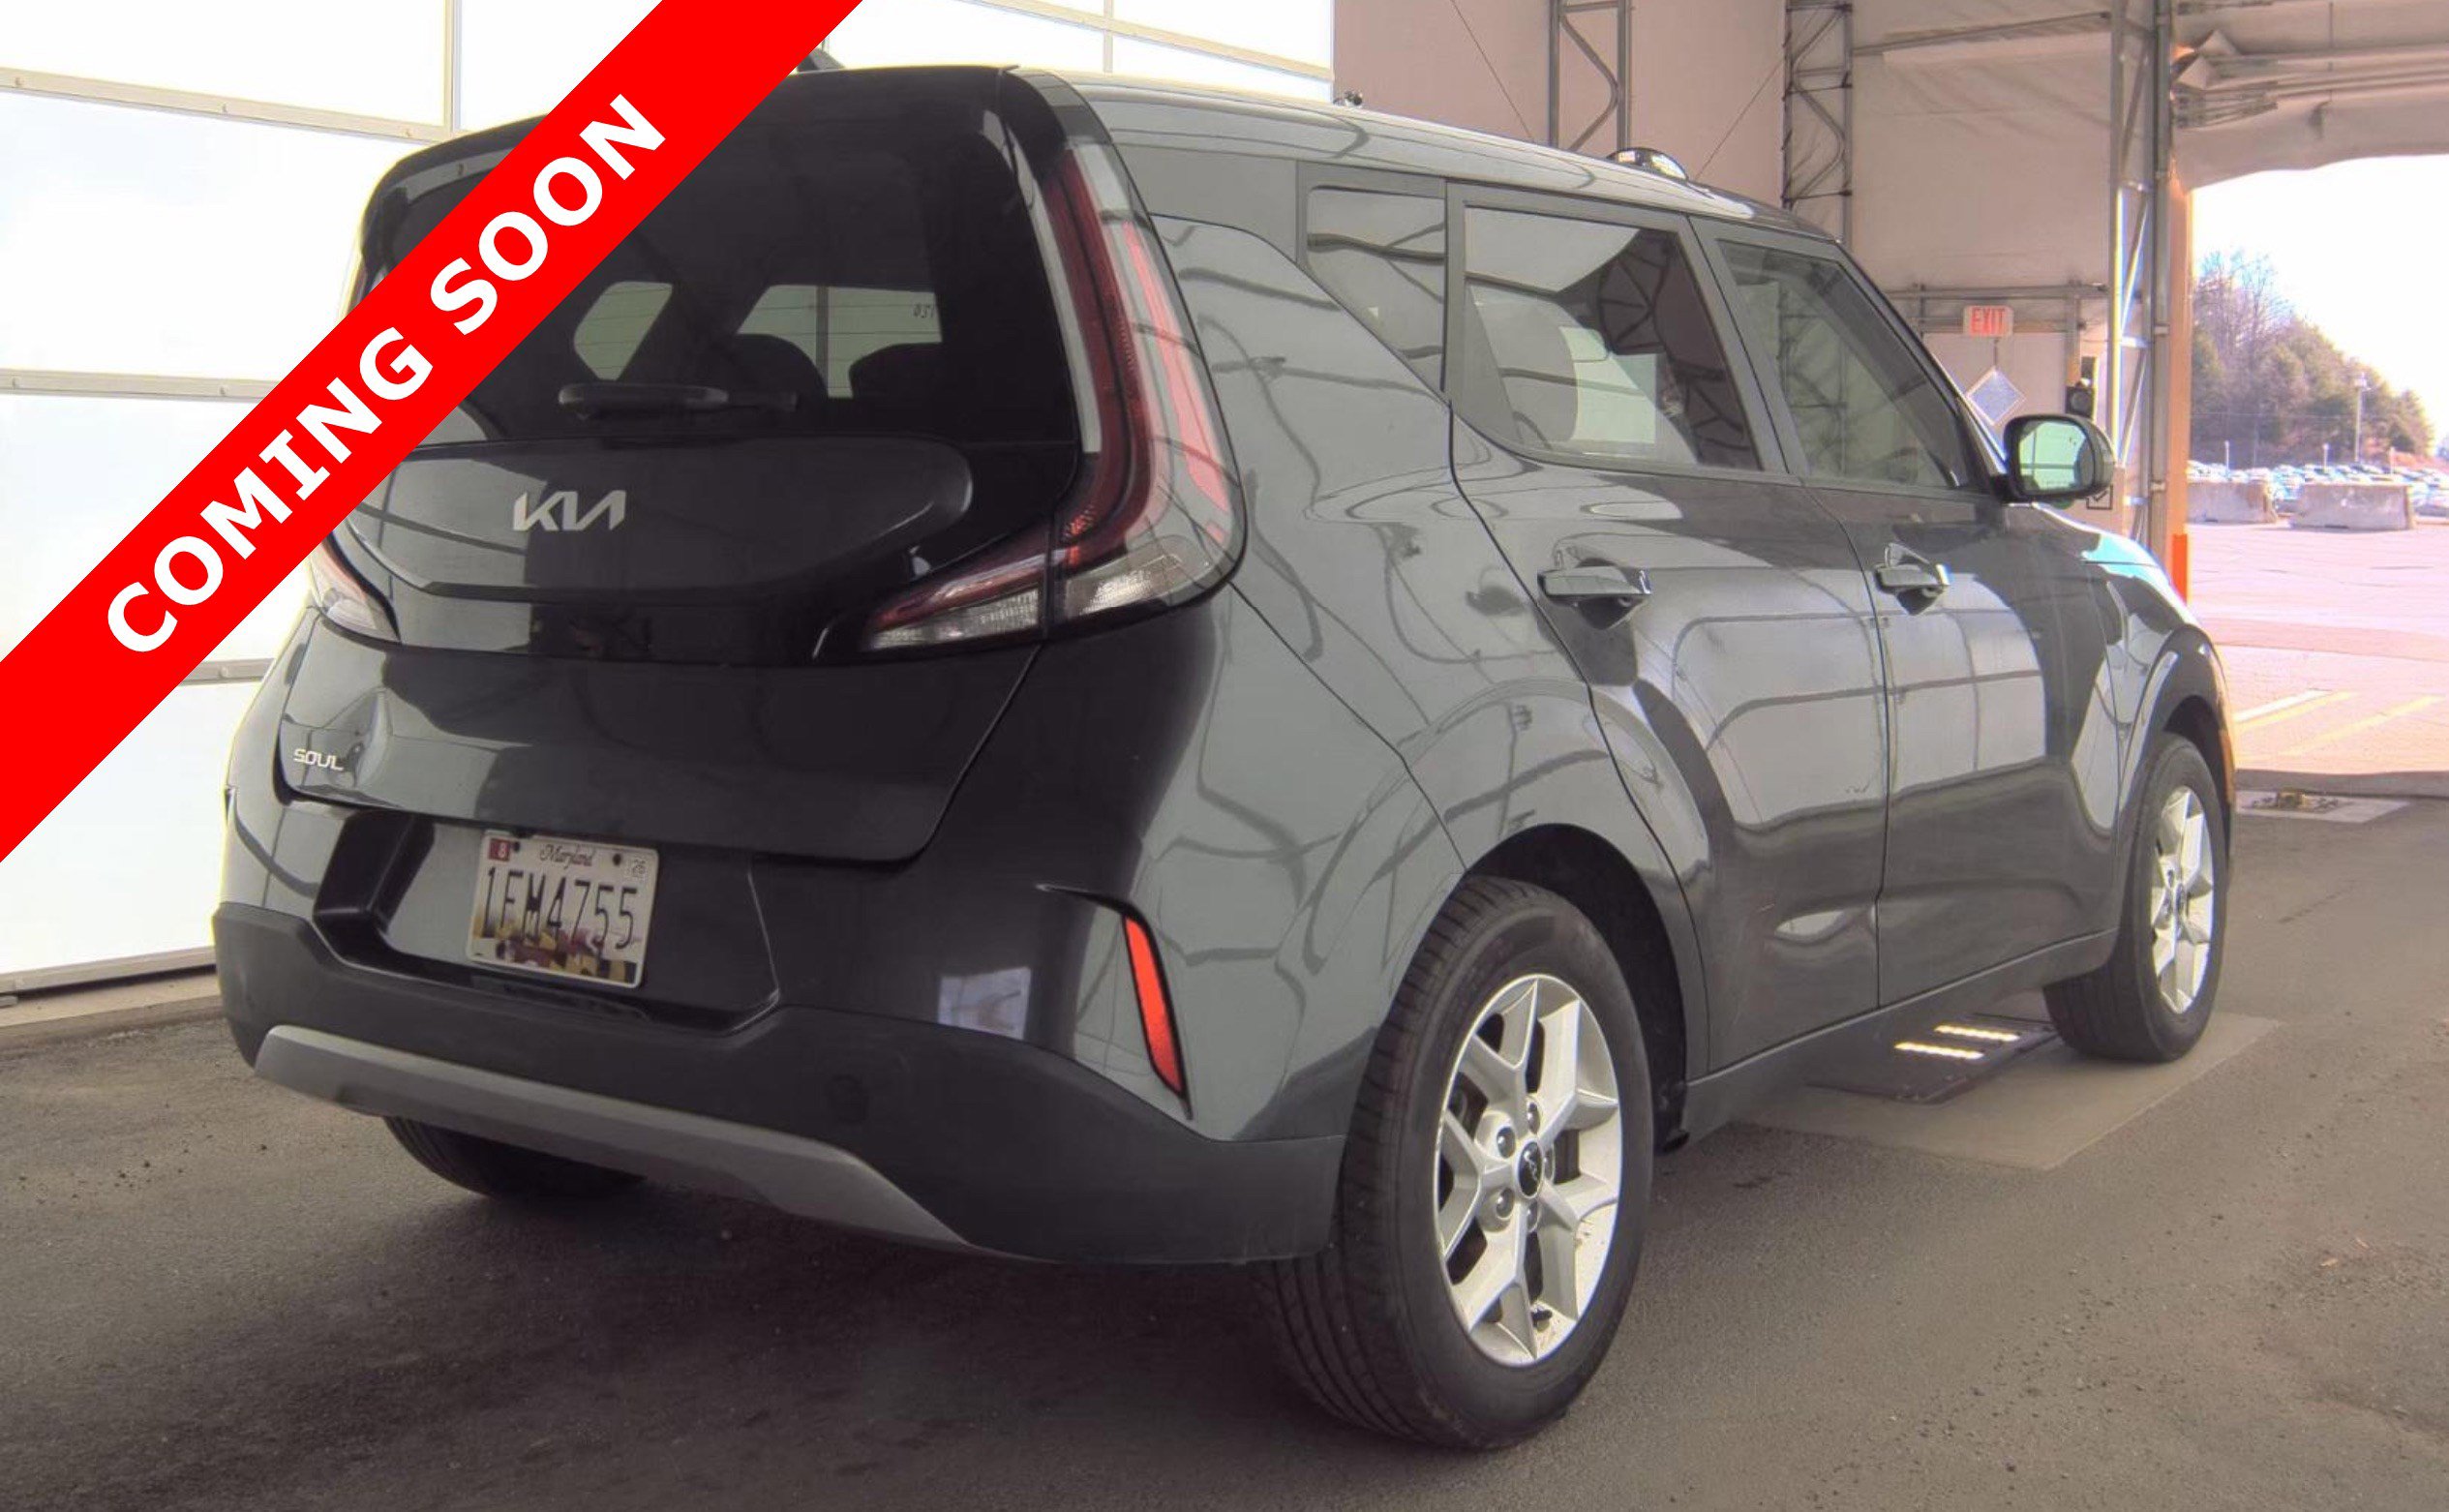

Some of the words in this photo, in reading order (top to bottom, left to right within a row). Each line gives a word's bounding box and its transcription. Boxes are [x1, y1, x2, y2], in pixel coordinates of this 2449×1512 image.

[1970, 307, 2006, 336] EXIT
[513, 490, 627, 531] KIA
[293, 748, 345, 771] SOUL
[539, 843, 596, 870] Maryland
[481, 866, 636, 951] 1FM4755
